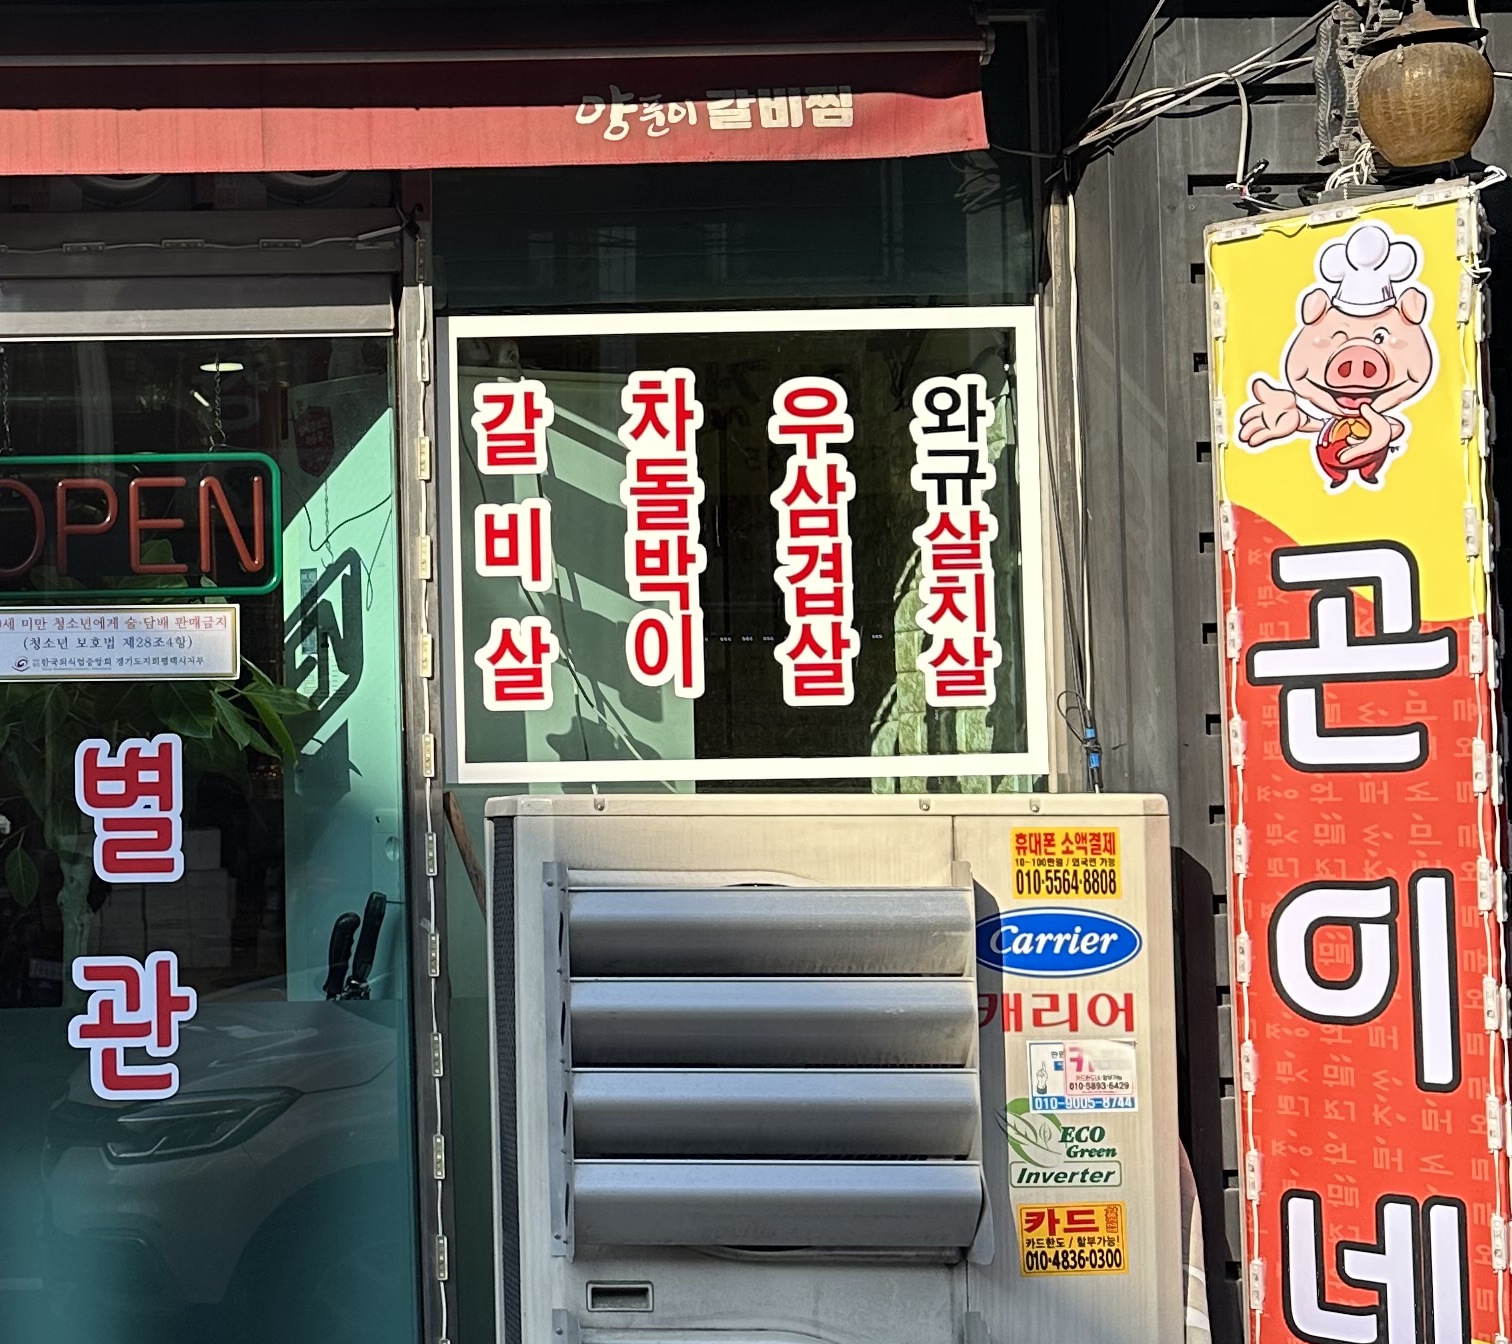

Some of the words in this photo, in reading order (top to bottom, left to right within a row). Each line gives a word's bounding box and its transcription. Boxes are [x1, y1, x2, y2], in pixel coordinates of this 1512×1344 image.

[706, 85, 854, 130] 갈비찜
[472, 380, 559, 711] 갈비살
[619, 368, 707, 699] 차돌박이
[768, 376, 860, 707] 우삼겹살
[21, 617, 47, 631] 미만
[52, 615, 119, 631] 청소년에게
[174, 615, 228, 630] 판매금지
[23, 636, 69, 651] (청소년
[76, 636, 115, 650] 보호법
[1015, 832, 1056, 856] 휴대폰
[1061, 832, 1116, 856] 소액결제
[68, 733, 197, 1100] 별관
[990, 925, 1119, 955] Carrier
[977, 992, 1135, 1032] 캐리어
[1058, 1126, 1106, 1143] ECO
[1066, 1144, 1118, 1158] Green
[1016, 1167, 1117, 1184] Inverter
[1024, 1207, 1100, 1237] 카드
